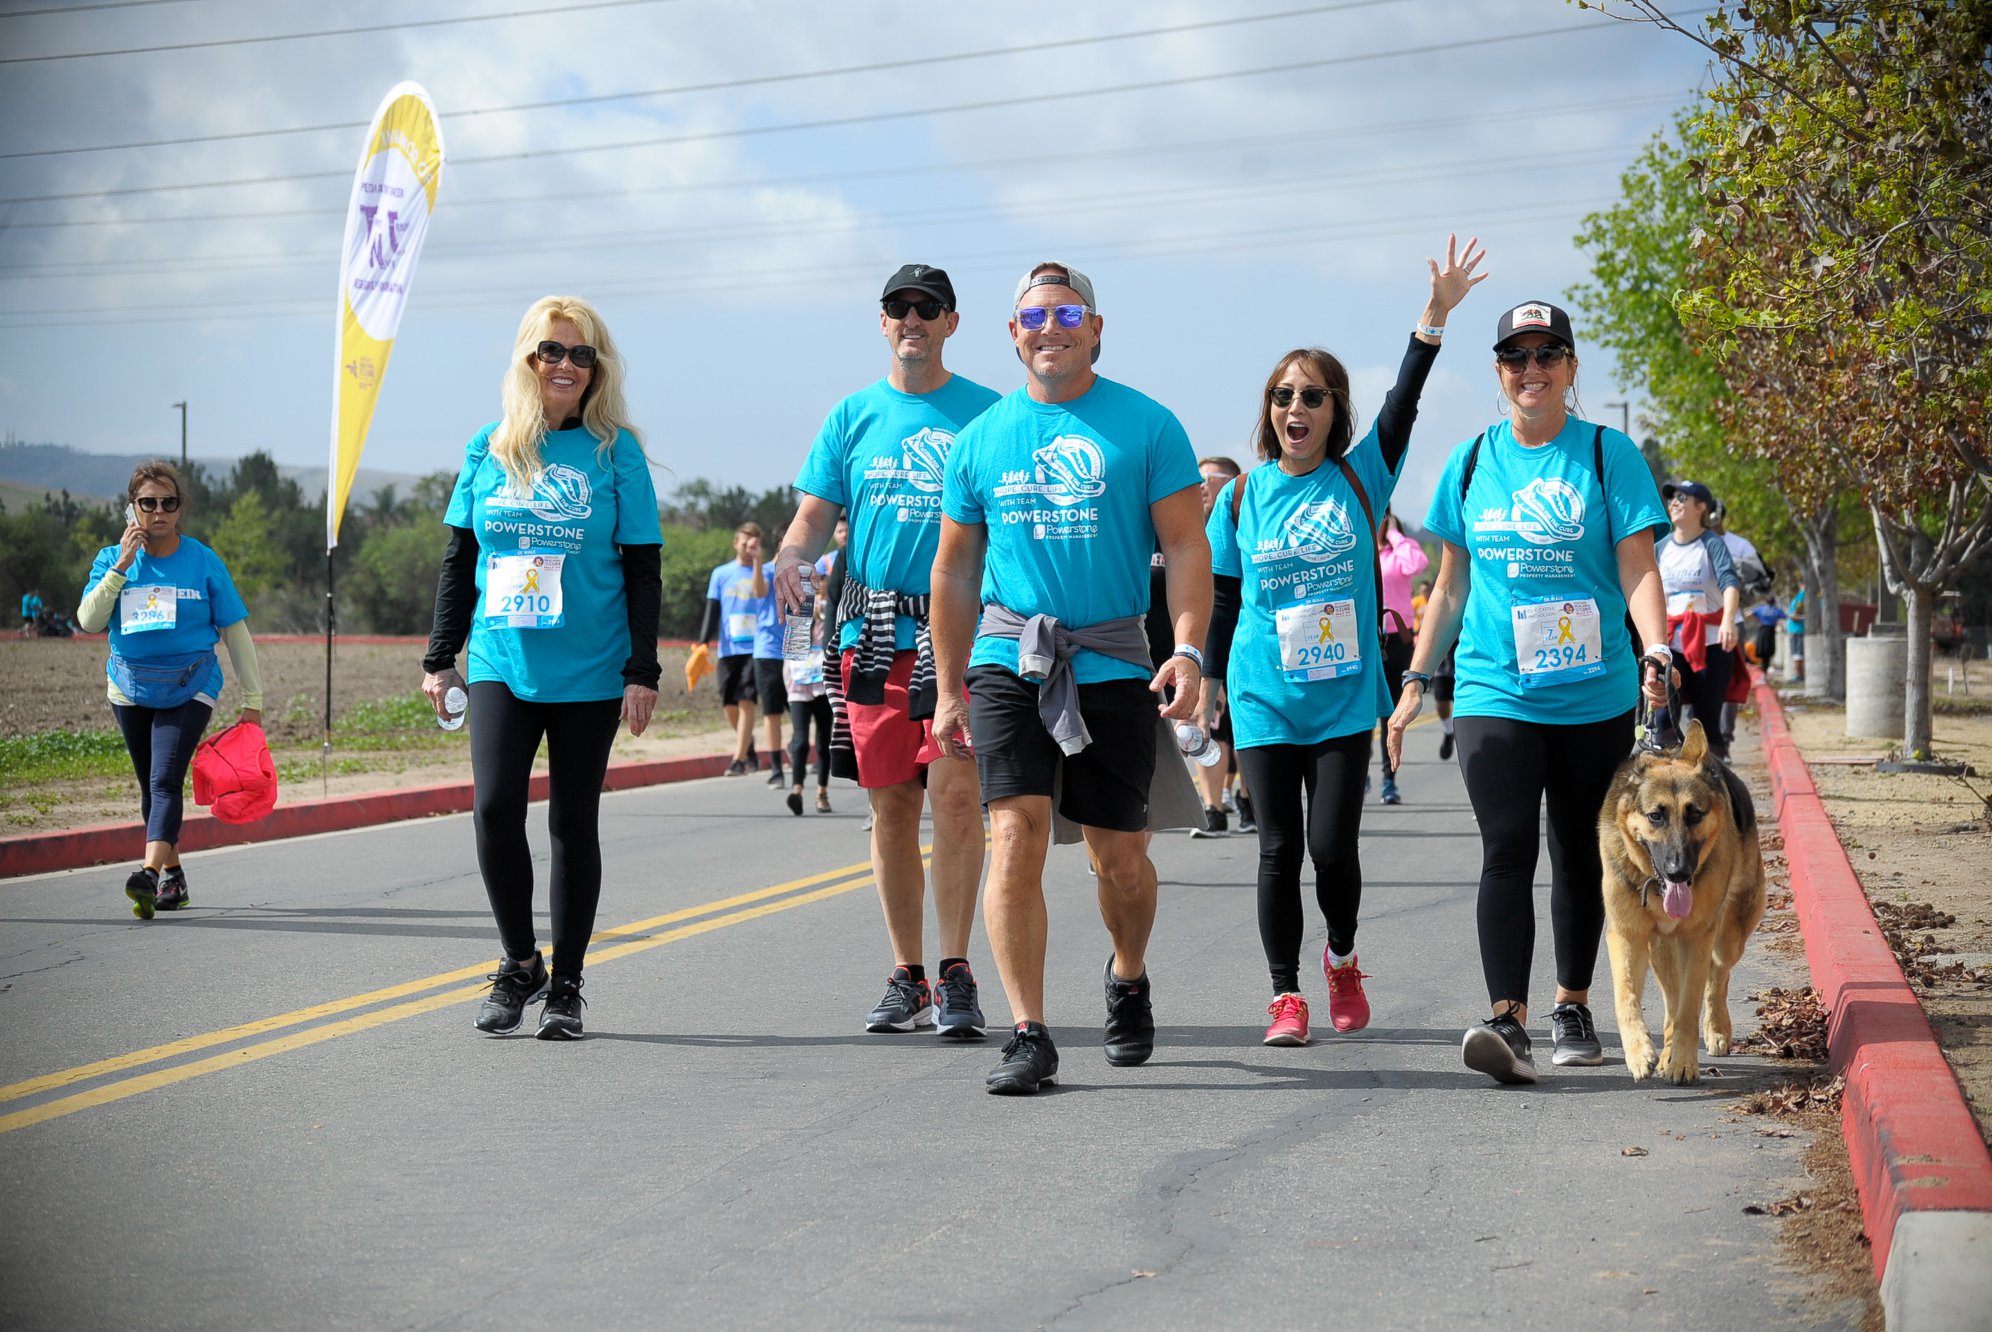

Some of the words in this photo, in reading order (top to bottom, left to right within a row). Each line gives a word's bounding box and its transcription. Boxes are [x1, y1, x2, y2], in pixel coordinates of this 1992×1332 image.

[870, 493, 941, 507] POWERSTO
[1000, 499, 1016, 507] WITH
[503, 510, 522, 518] TEAM
[909, 508, 941, 518] Powers
[1001, 507, 1099, 525] POWERSTONE
[484, 520, 585, 540] POWERSTONE
[1046, 524, 1098, 535] Powerstone
[531, 537, 582, 550] Powerstone
[1300, 544, 1317, 553] LIFE
[1477, 547, 1575, 562] POWERSTONE
[1275, 562, 1294, 570] TEAM
[1520, 562, 1574, 573] Powerstone
[1260, 559, 1354, 591] POWERSTONE
[501, 595, 550, 612] 2910
[1548, 629, 1553, 637] 7
[1298, 642, 1345, 666] 2940
[1535, 643, 1587, 669] 2394
